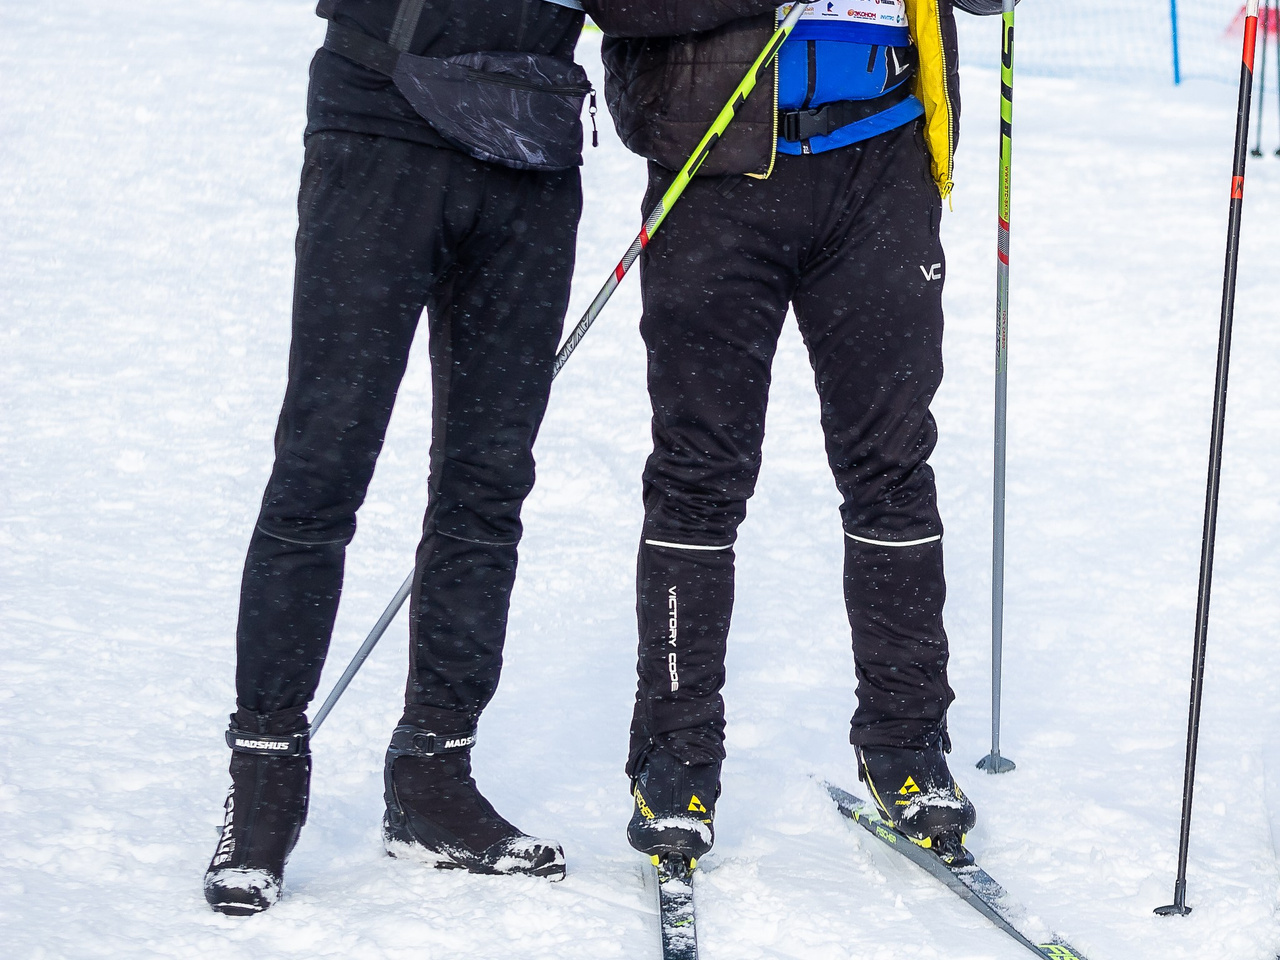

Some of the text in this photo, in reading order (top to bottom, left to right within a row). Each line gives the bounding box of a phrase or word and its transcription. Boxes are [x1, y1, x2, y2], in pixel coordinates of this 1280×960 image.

[667, 585, 680, 693] VICTORY CODE
[235, 738, 290, 751] MADSHUS
[875, 825, 897, 844] FISCHER
